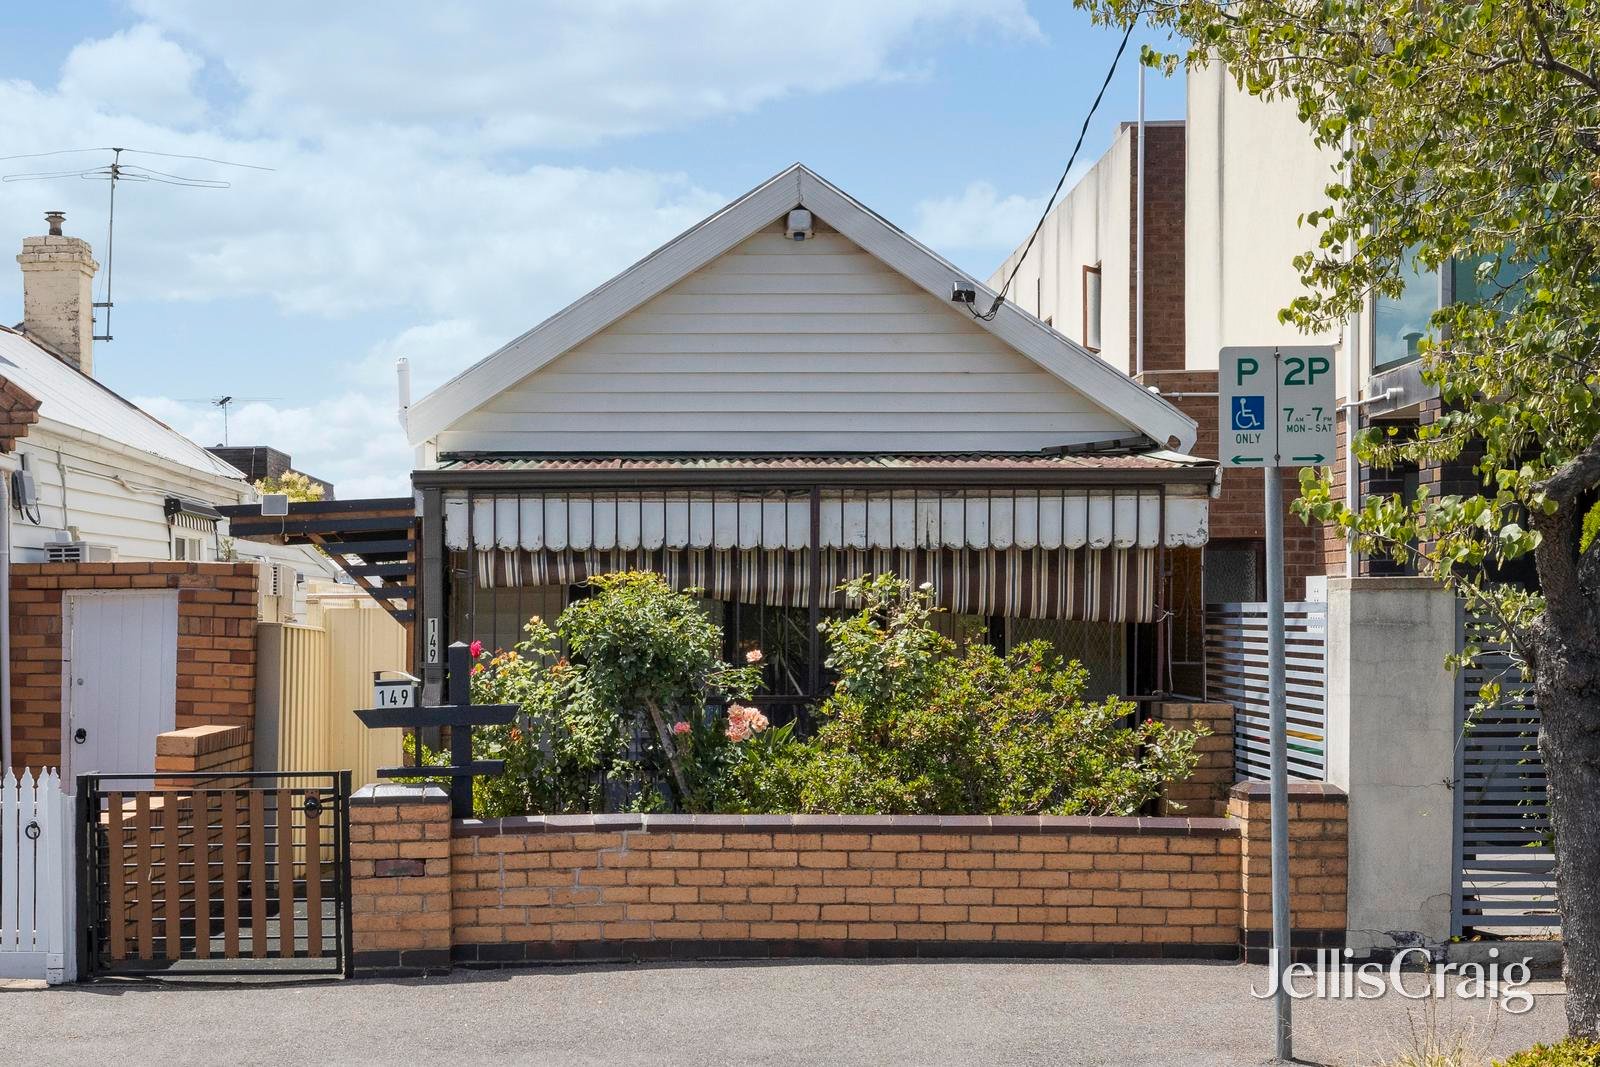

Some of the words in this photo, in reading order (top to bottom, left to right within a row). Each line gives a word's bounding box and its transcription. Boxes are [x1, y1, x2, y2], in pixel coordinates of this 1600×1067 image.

[1237, 358, 1259, 386] P
[1284, 357, 1330, 386] 2P
[1235, 433, 1261, 444] ONLY
[378, 689, 409, 706] 149
